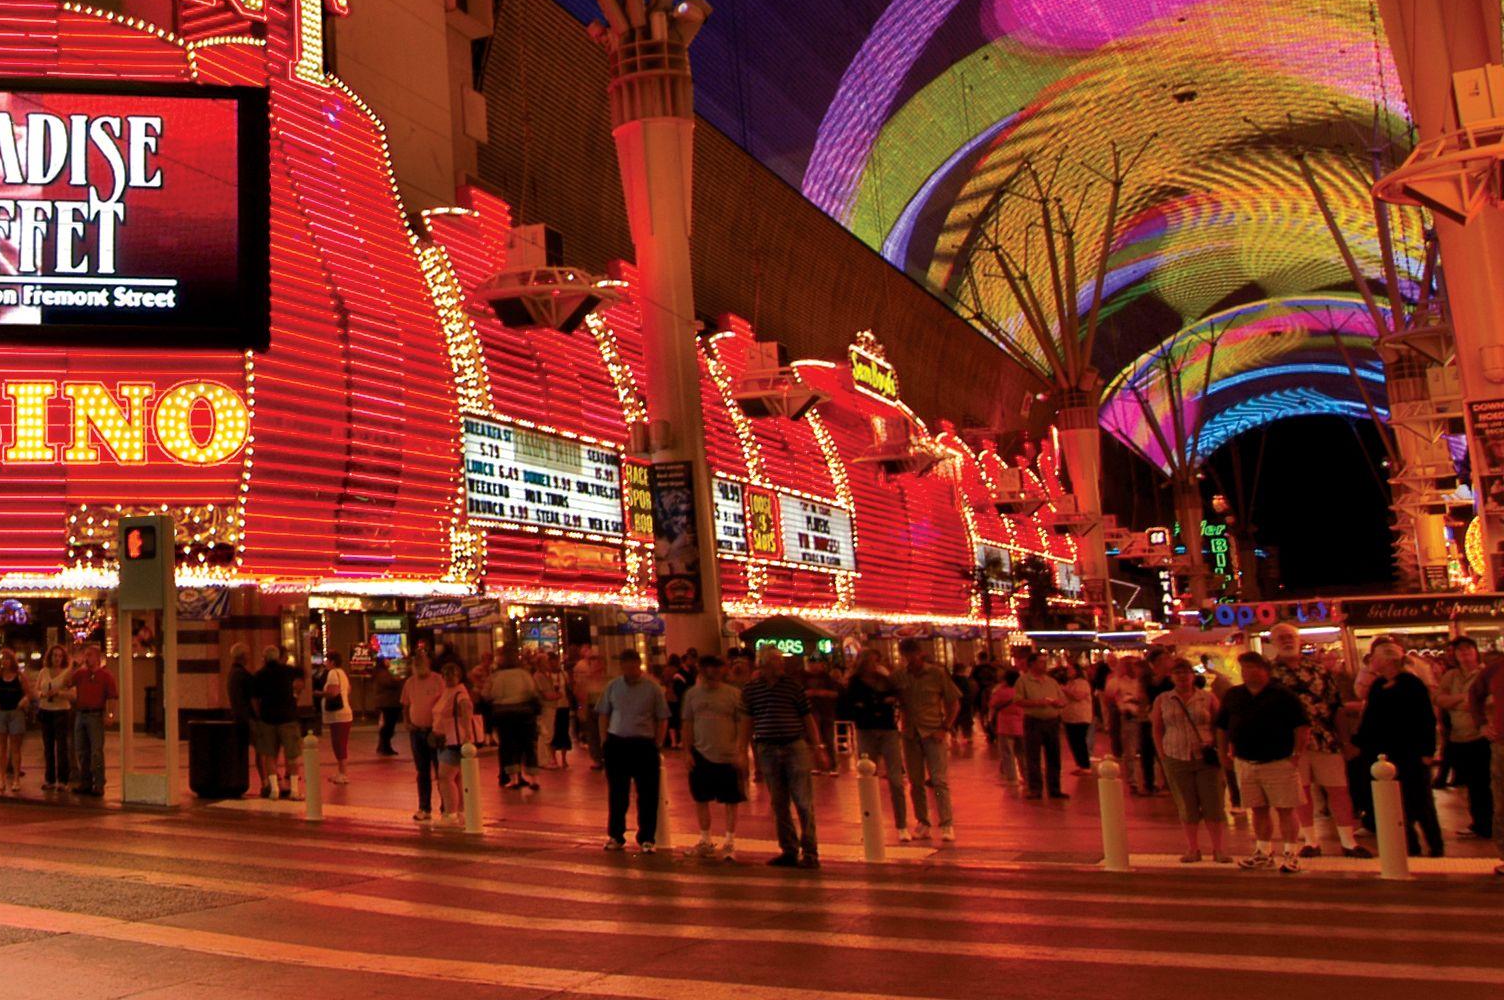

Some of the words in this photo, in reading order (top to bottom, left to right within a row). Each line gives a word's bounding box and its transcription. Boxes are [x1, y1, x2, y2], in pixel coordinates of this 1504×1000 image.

[22, 286, 109, 306] Fremont
[113, 286, 177, 308] Street
[625, 464, 649, 486] RACE
[468, 478, 510, 499] WEEKEND
[634, 514, 654, 534] BOO
